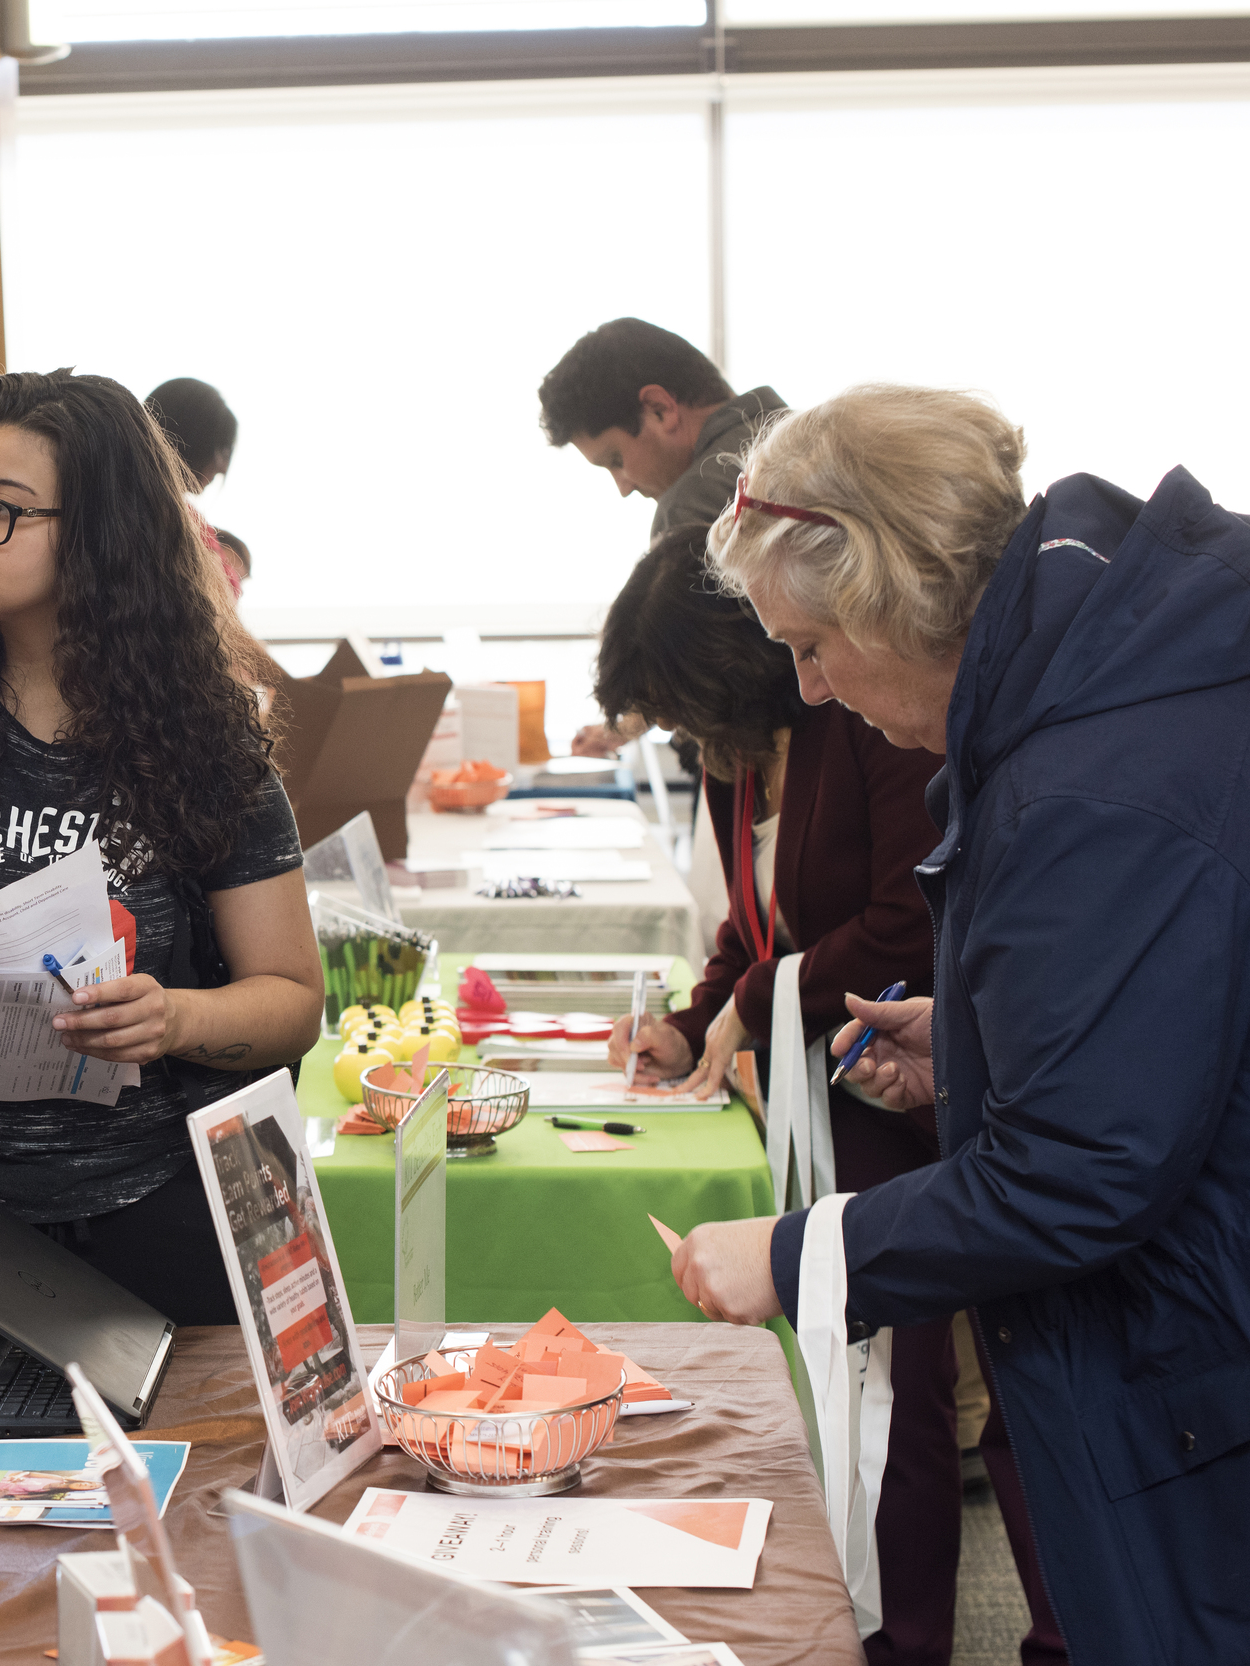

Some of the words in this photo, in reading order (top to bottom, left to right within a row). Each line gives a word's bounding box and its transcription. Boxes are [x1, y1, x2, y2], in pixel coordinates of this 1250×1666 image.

[20, 852, 34, 864] OF
[213, 1144, 242, 1176] Track
[221, 1181, 245, 1205] Earn
[243, 1163, 273, 1194] Points
[229, 1206, 247, 1232] Get
[246, 1180, 290, 1223] Rewarded
[431, 1513, 478, 1560] GIVEAWAY!
[496, 1524, 516, 1538] hour
[534, 1516, 562, 1538] training
[568, 1527, 590, 1554] sessions!
[526, 1538, 549, 1563] personal
